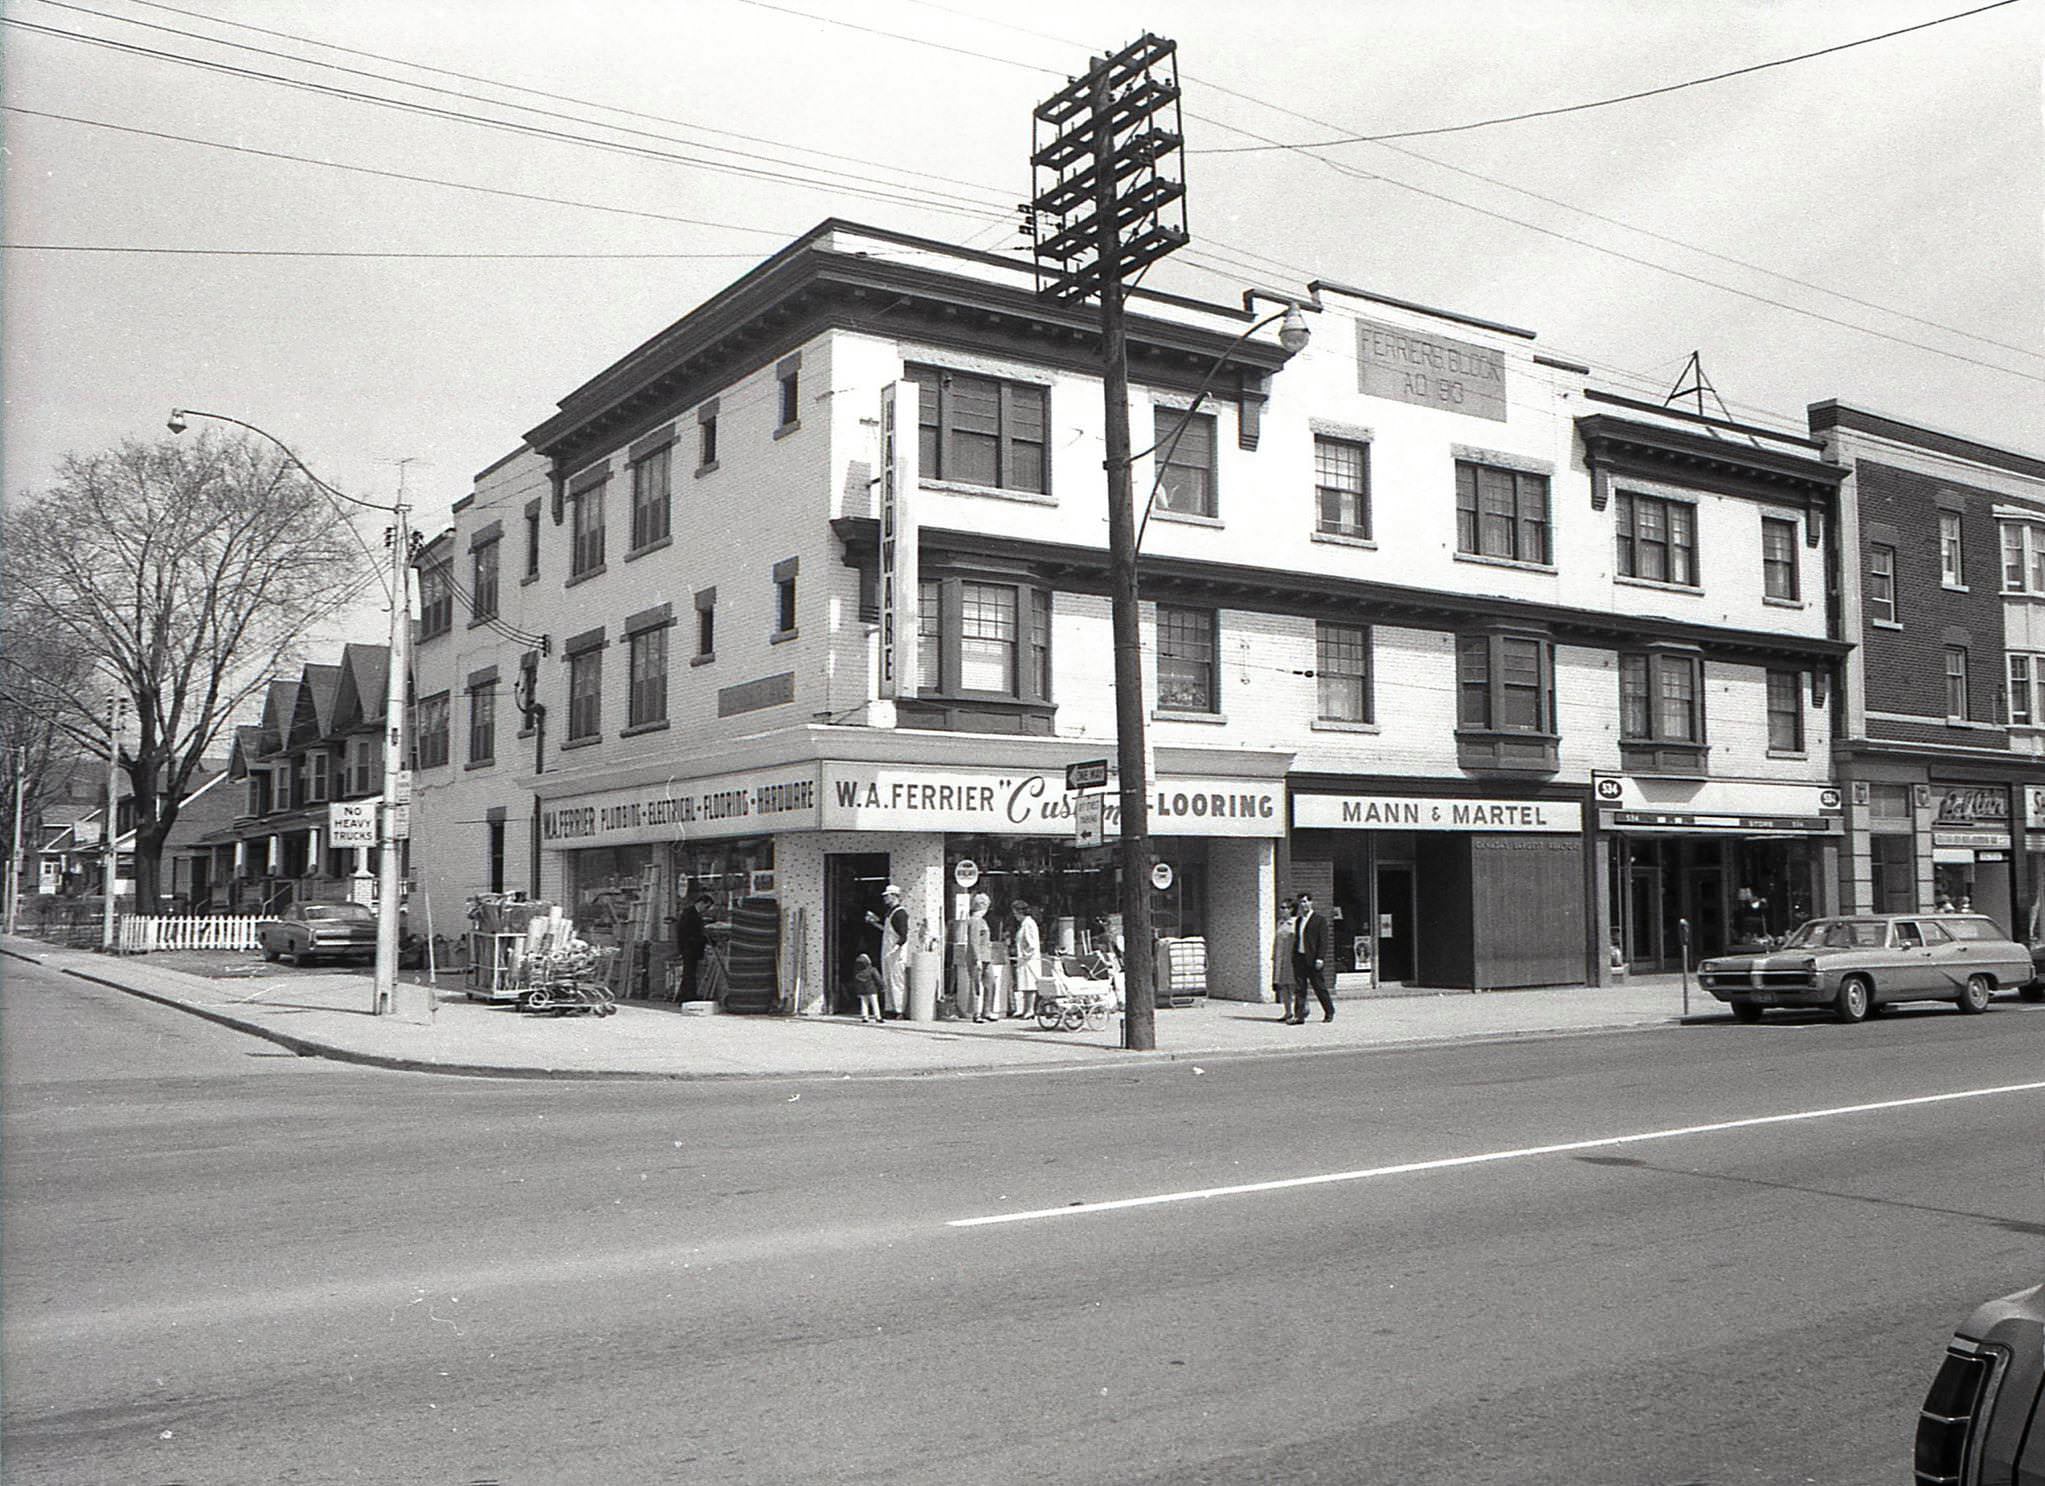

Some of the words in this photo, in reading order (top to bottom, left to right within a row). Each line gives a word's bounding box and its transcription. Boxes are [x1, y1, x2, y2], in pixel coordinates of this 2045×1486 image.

[883, 400, 896, 681] HARDWARE
[757, 780, 813, 814] HARDWARE
[1602, 782, 1618, 795] 534
[344, 807, 362, 816] NO
[1147, 792, 1272, 818] LOORING
[1342, 801, 1419, 823] MANN
[1432, 806, 1441, 822] &
[1453, 804, 1548, 826] MARTEL
[335, 819, 371, 829] HEAVY
[333, 832, 373, 841] TRUCKS
